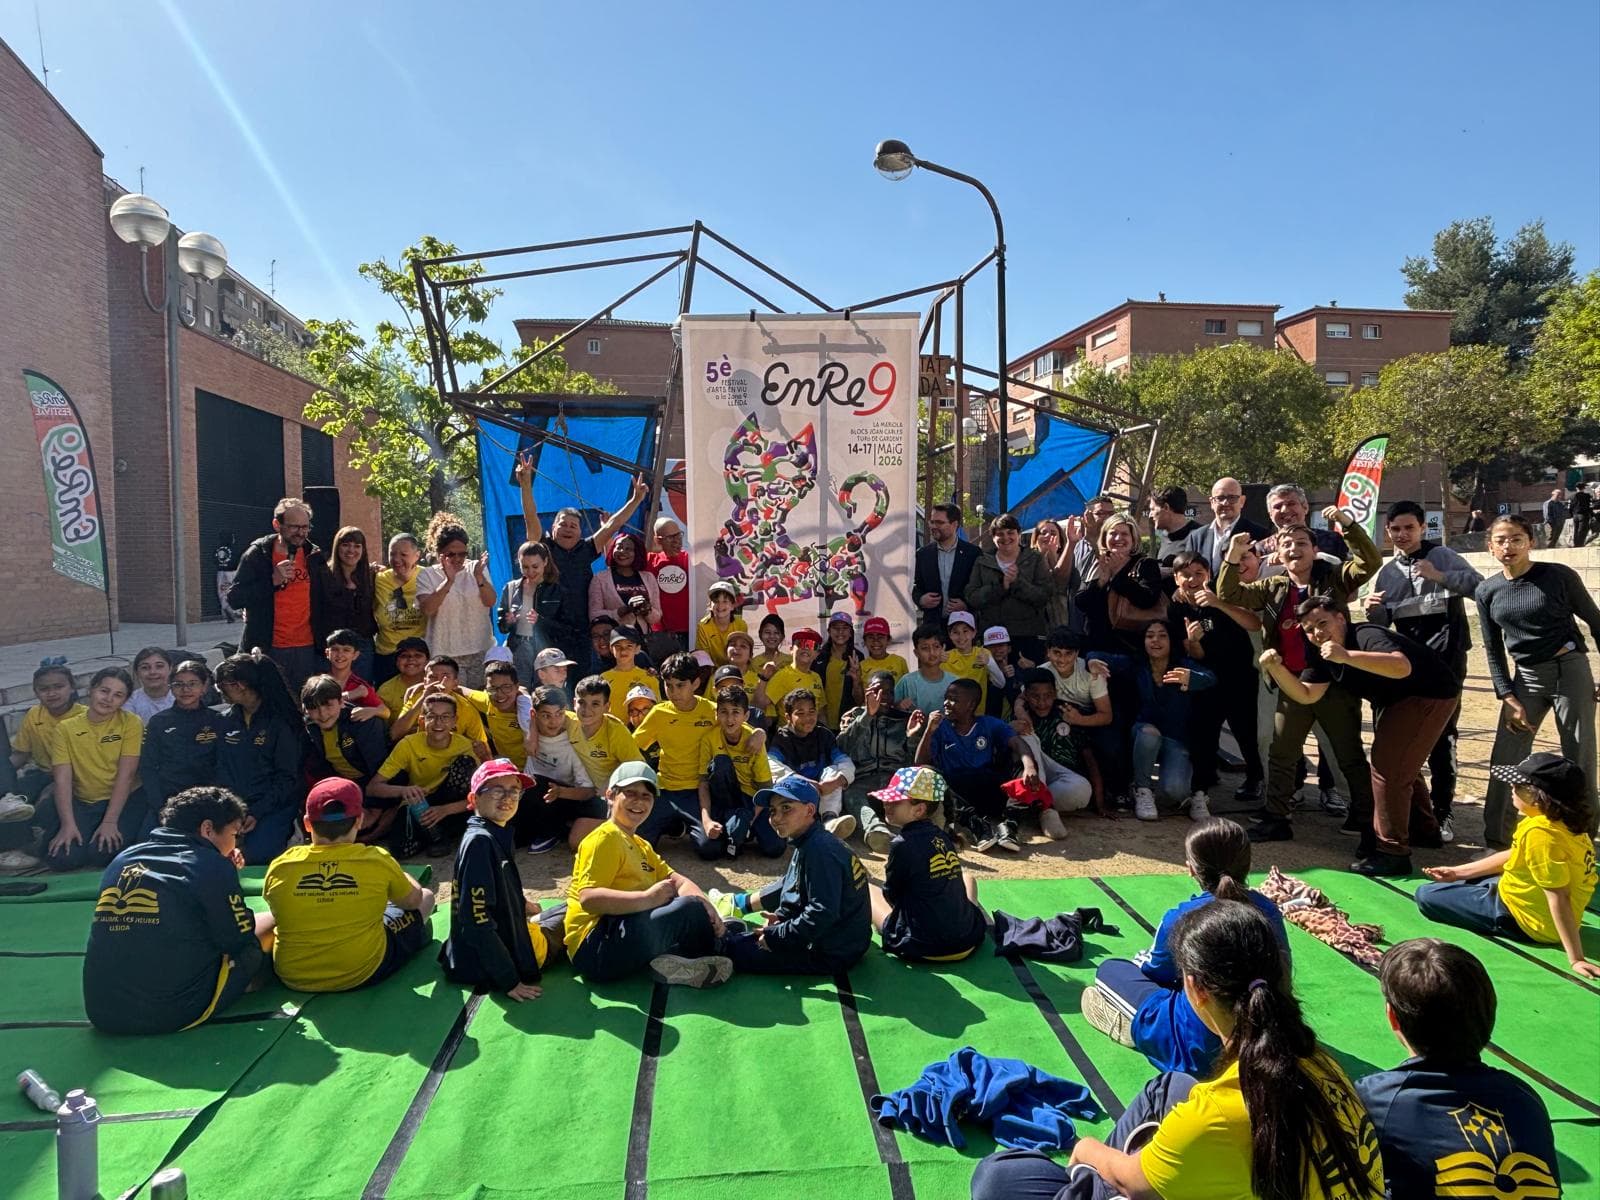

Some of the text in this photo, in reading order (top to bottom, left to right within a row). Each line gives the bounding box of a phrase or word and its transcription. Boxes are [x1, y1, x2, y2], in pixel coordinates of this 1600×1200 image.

[706, 354, 732, 383] 5è
[760, 361, 896, 416] EnRe9
[919, 376, 943, 396] DA
[847, 443, 872, 454] 14-17
[878, 455, 903, 466] 2026
[229, 894, 252, 933] SJLH
[471, 887, 489, 924] SJLH
